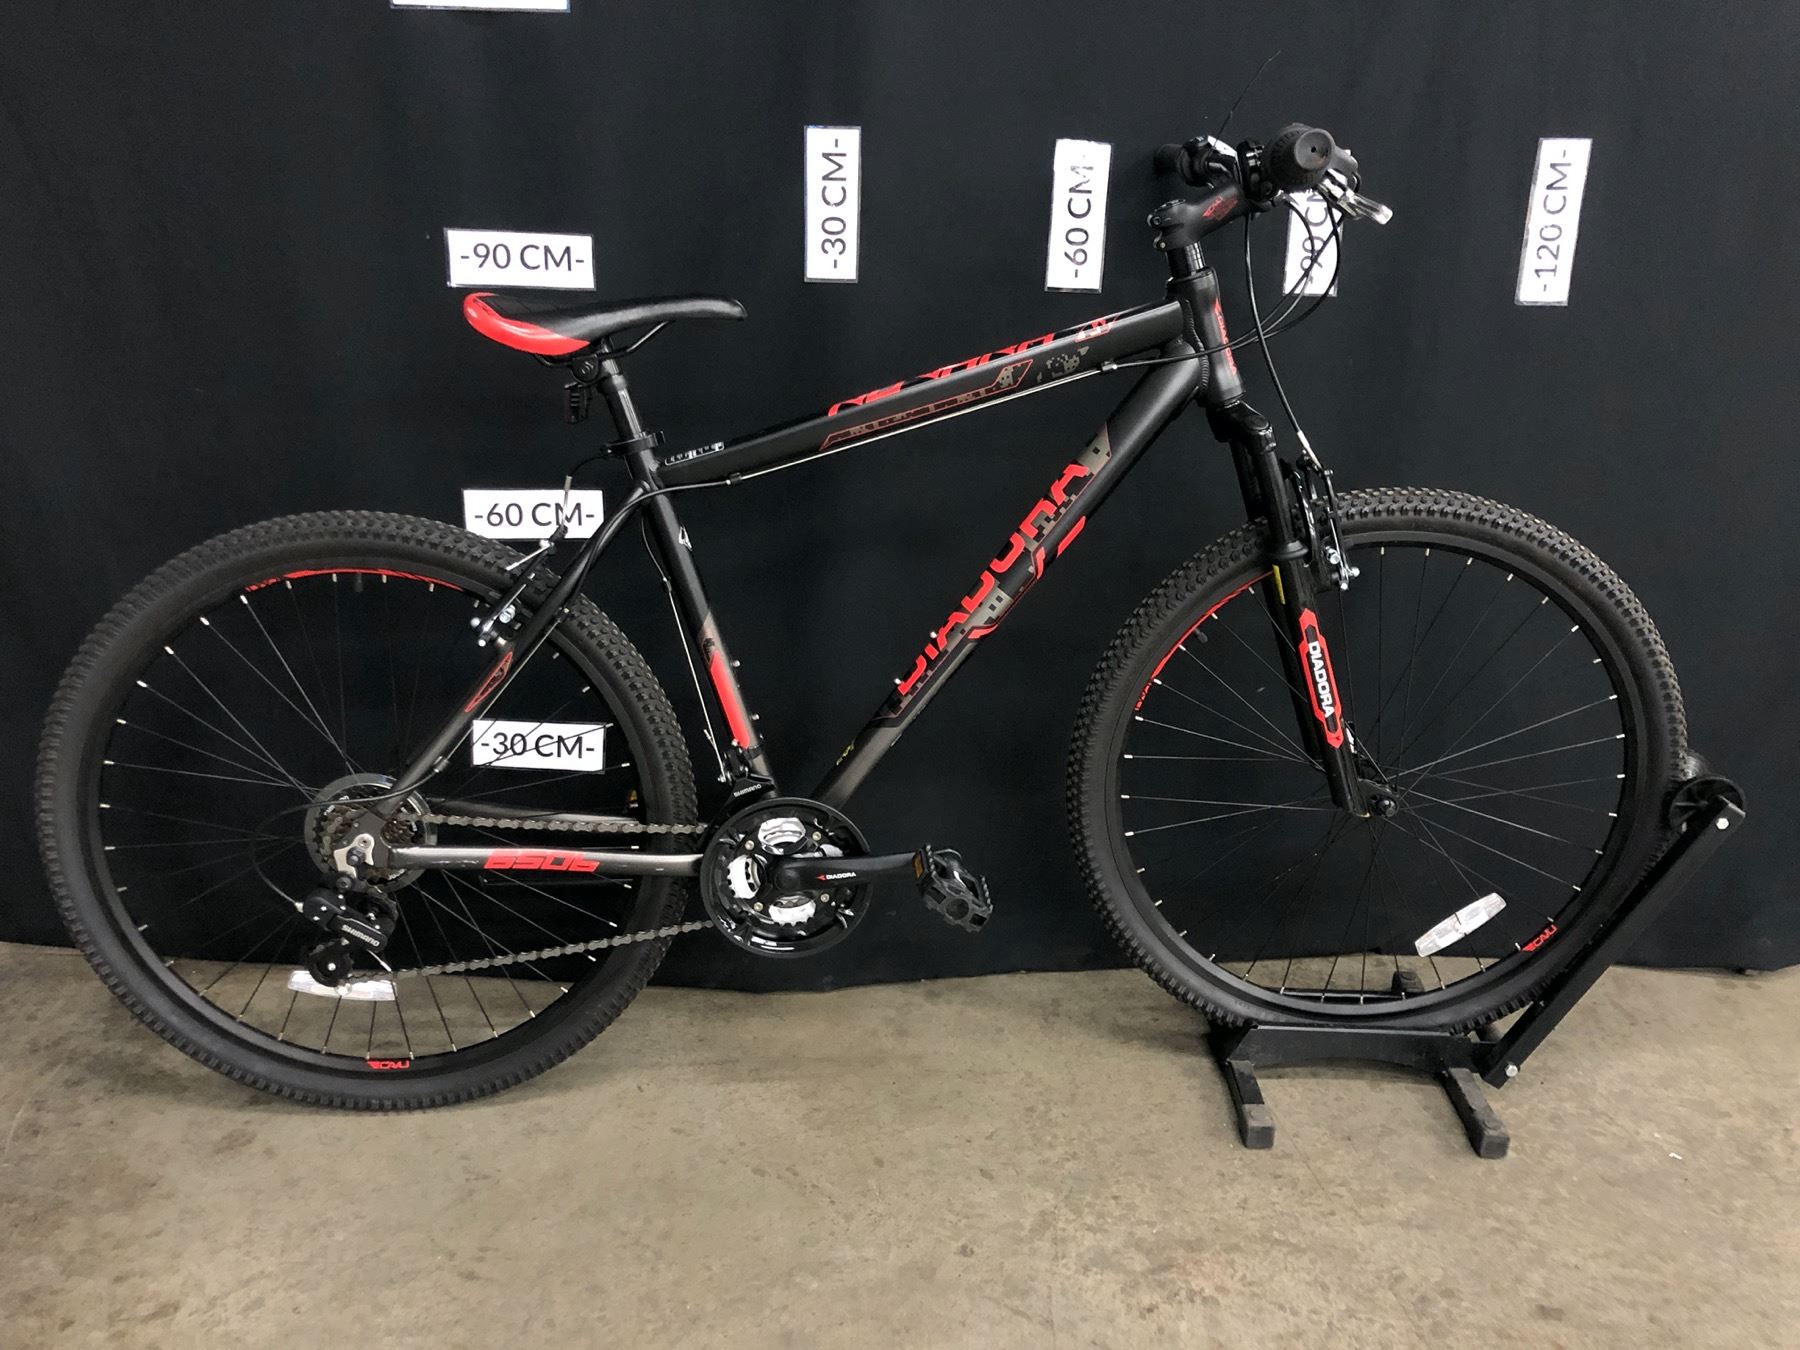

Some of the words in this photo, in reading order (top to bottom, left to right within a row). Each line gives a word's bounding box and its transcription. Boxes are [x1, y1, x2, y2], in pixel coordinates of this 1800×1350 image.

[821, 137, 848, 208] CM-
[1543, 149, 1573, 216] CM-
[459, 242, 512, 271] -90
[519, 243, 586, 272] CM-
[821, 214, 848, 270] -30
[1064, 226, 1090, 279] -60
[1534, 223, 1563, 292] -120
[474, 502, 524, 528] -60
[531, 501, 596, 528] CM-
[1307, 640, 1336, 719] DIADORA
[480, 731, 528, 757] -30
[534, 733, 596, 760] CM-
[825, 871, 857, 881] DIADORA
